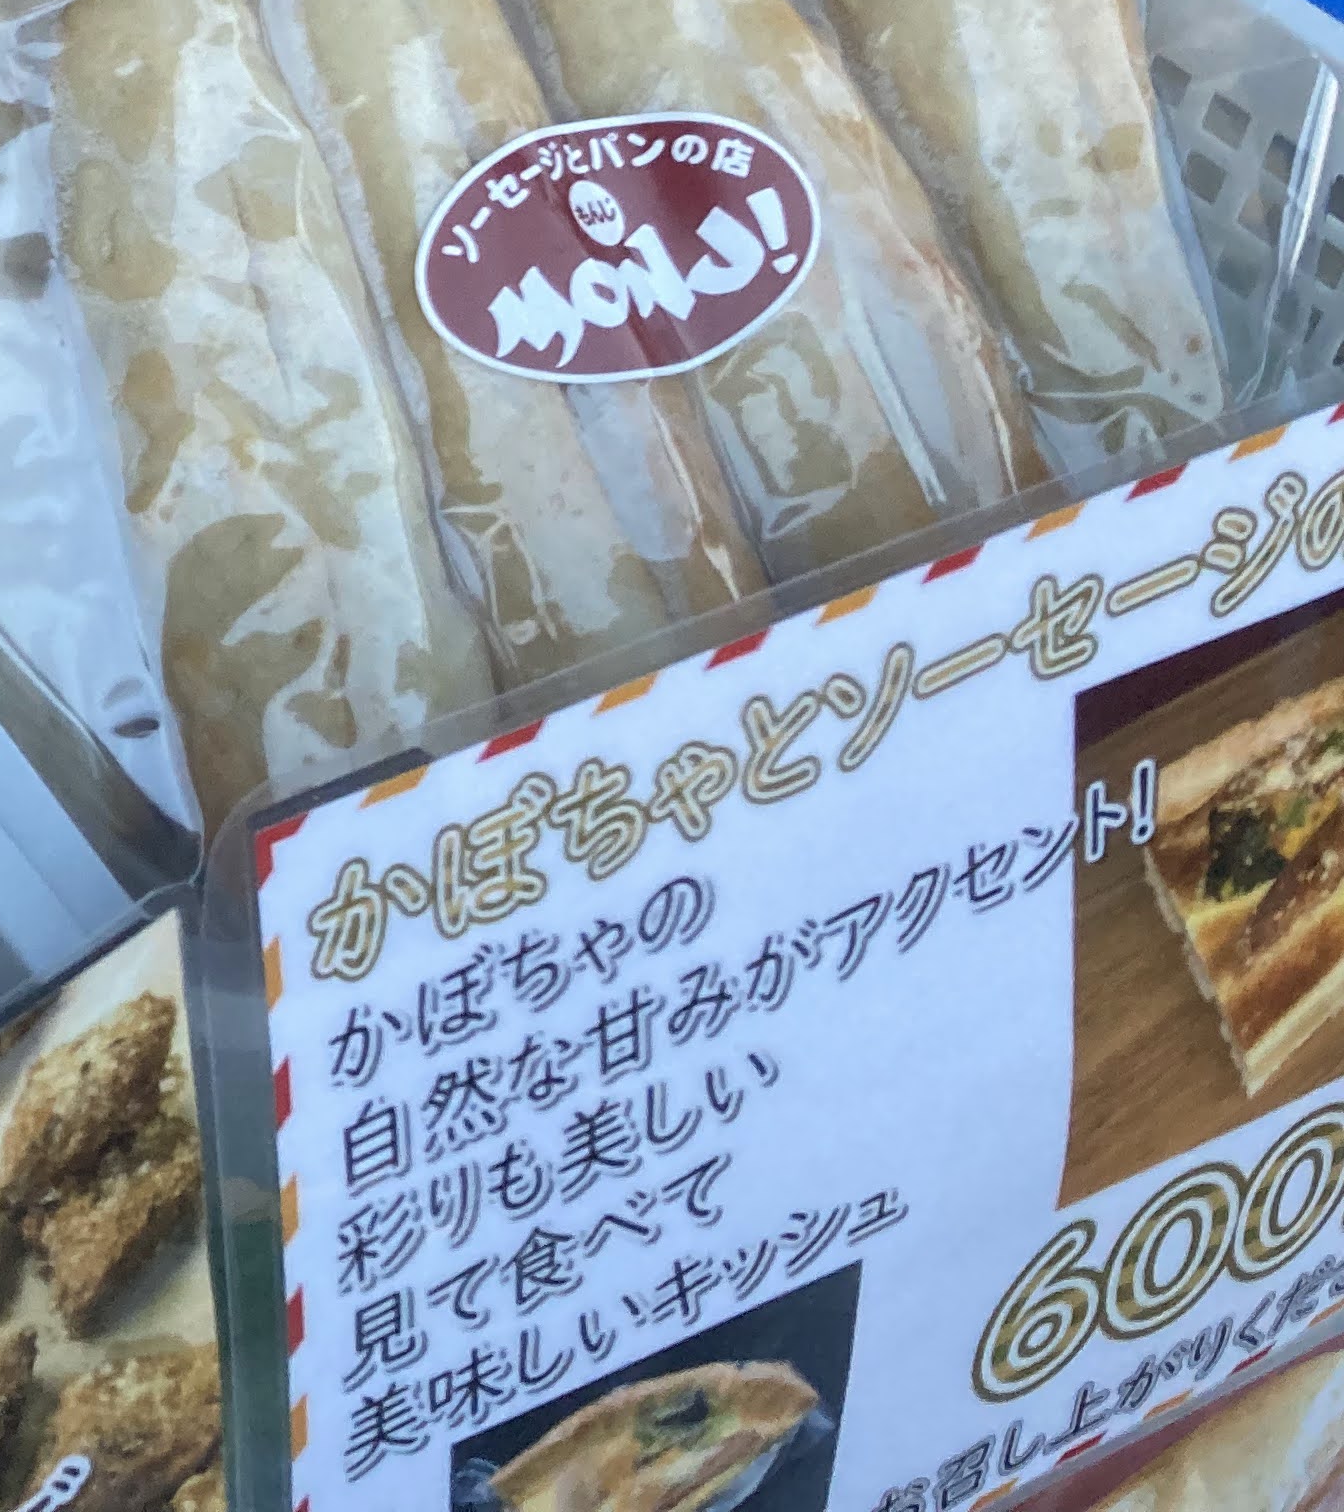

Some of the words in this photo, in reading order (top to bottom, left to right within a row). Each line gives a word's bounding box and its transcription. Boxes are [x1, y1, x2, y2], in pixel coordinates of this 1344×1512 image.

[441, 131, 755, 264] ソーセージとパンの店
[329, 875, 711, 1085] かぼちゃの
[338, 1052, 776, 1292] 彩りも美しい
[343, 1154, 731, 1388] 見て食べて
[345, 1188, 907, 1479] 美味しいキッシュ
[871, 1254, 1344, 1512] お召し上がりくだ
